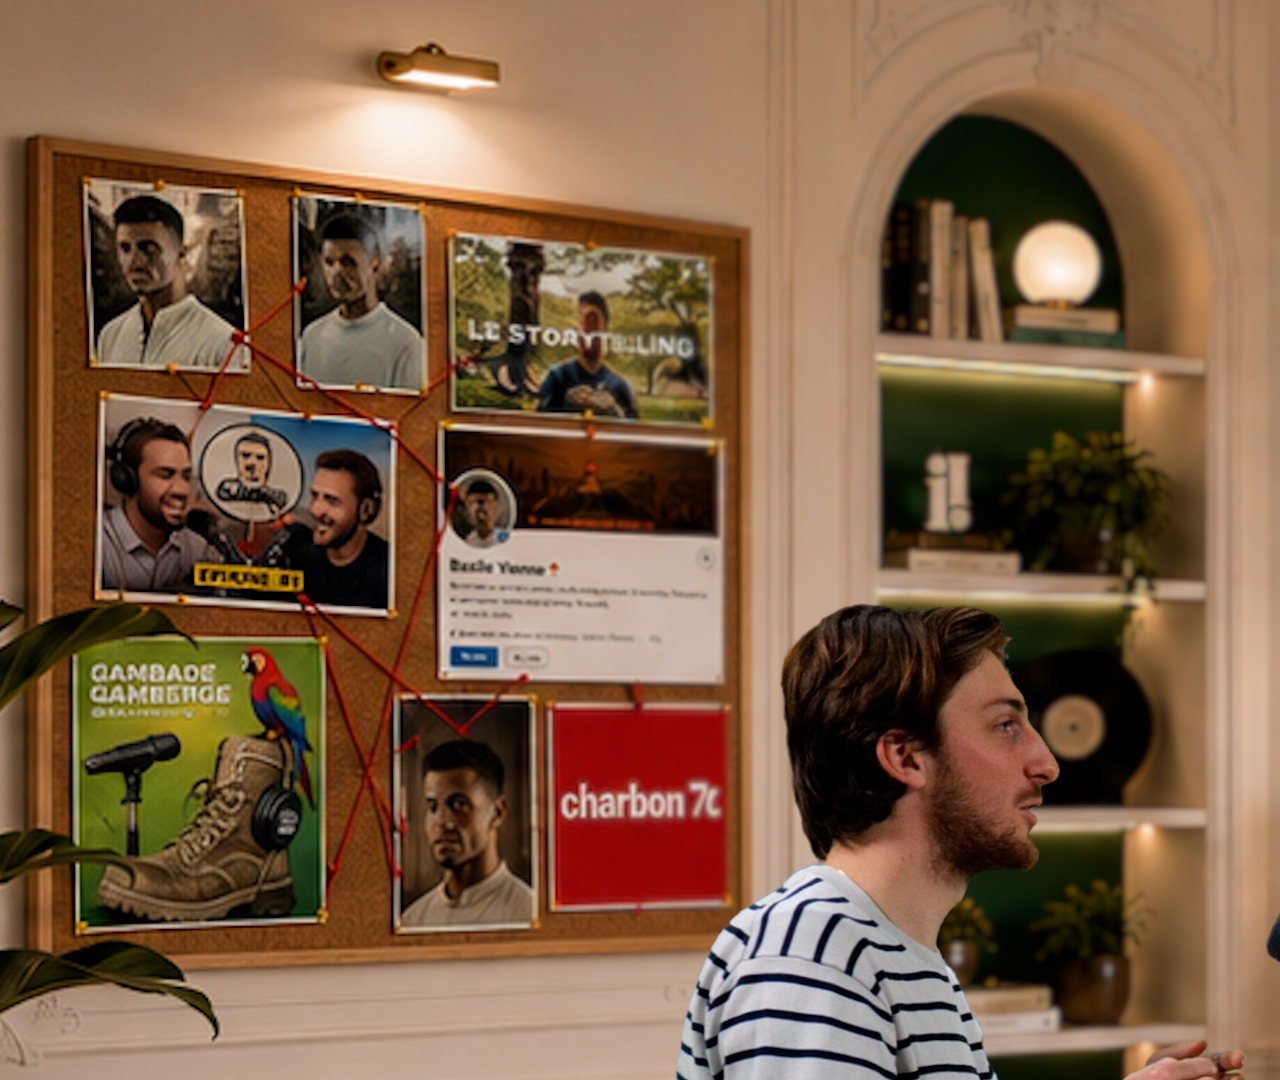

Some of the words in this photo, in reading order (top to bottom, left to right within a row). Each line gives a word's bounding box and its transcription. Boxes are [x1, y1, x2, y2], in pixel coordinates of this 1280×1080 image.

[467, 318, 499, 342] LE
[508, 322, 695, 360] STORYTELLING
[561, 782, 686, 819] charbon
